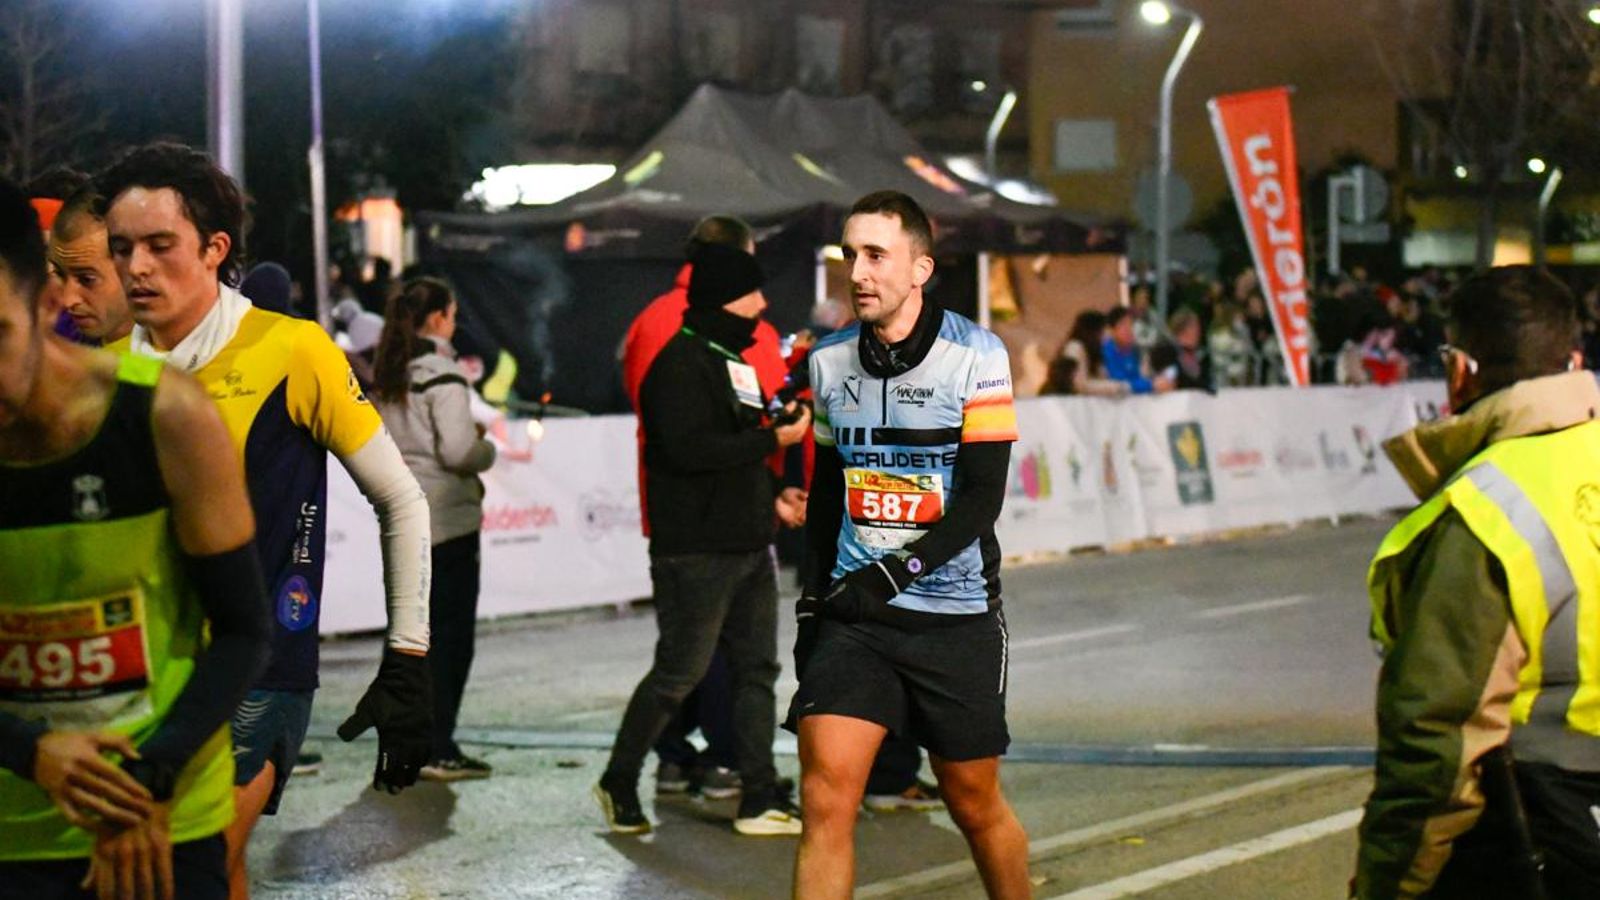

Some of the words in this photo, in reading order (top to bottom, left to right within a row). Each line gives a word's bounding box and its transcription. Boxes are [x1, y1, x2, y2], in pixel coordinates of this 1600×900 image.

[976, 379, 1005, 390] Allianz
[851, 451, 957, 468] CAUDETE
[862, 491, 922, 521] 587
[0, 636, 115, 687] 495
